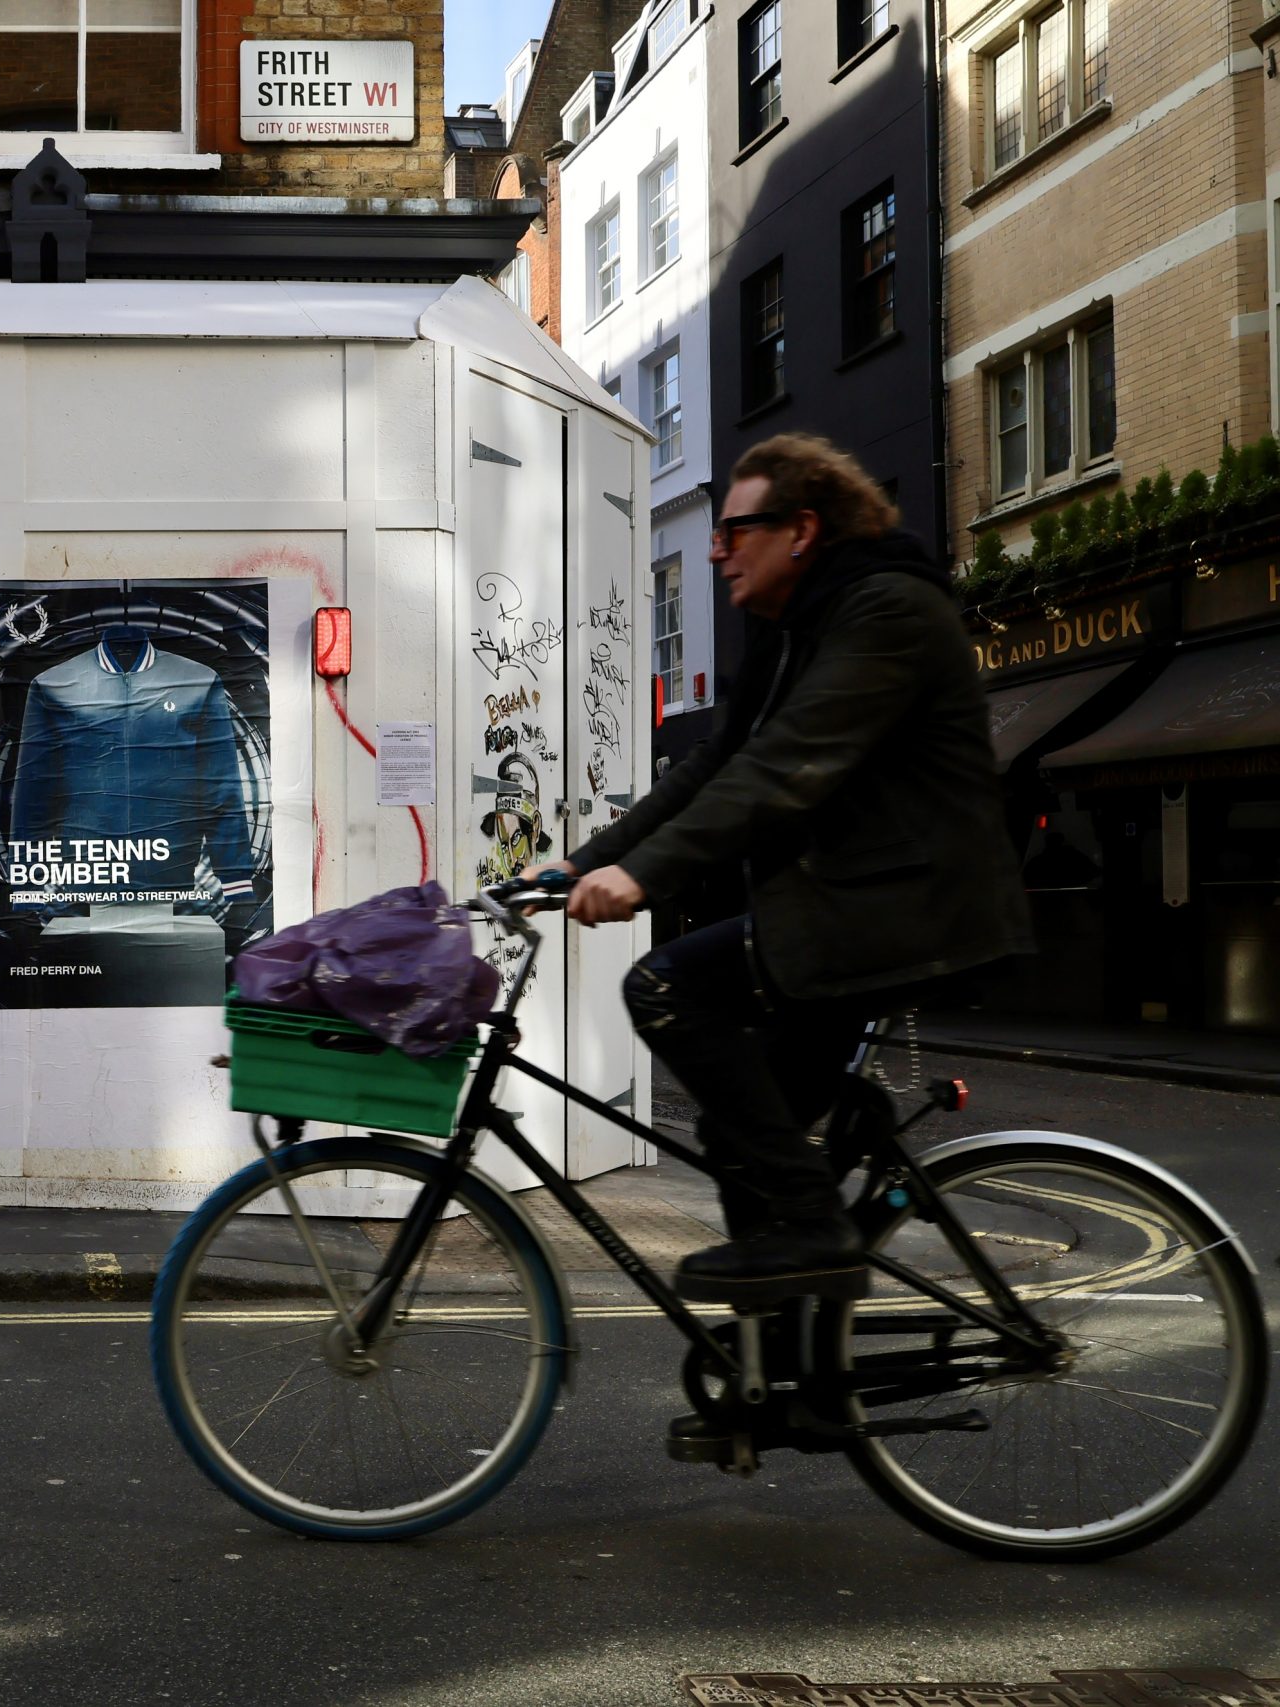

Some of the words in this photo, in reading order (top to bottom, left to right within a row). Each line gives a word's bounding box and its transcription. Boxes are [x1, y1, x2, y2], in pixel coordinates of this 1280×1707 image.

[258, 50, 329, 75] FRITH
[258, 82, 352, 107] STREET
[363, 82, 398, 107] W1
[258, 122, 283, 134] CITY
[288, 122, 302, 134] OF
[306, 122, 390, 134] WESTMINSTER
[1008, 639, 1046, 666] AND
[1052, 600, 1143, 655] DUCK
[8, 840, 62, 863] THE
[69, 838, 170, 862] TENNIS
[10, 862, 130, 886] BOMBER
[9, 893, 44, 903] FROM
[42, 892, 118, 902] SPORTSWEAR
[119, 892, 135, 901] TO
[137, 891, 213, 901] STREETWEAR.
[10, 966, 38, 976] FRED
[40, 966, 76, 976] PERRY
[79, 965, 102, 975] DNA
